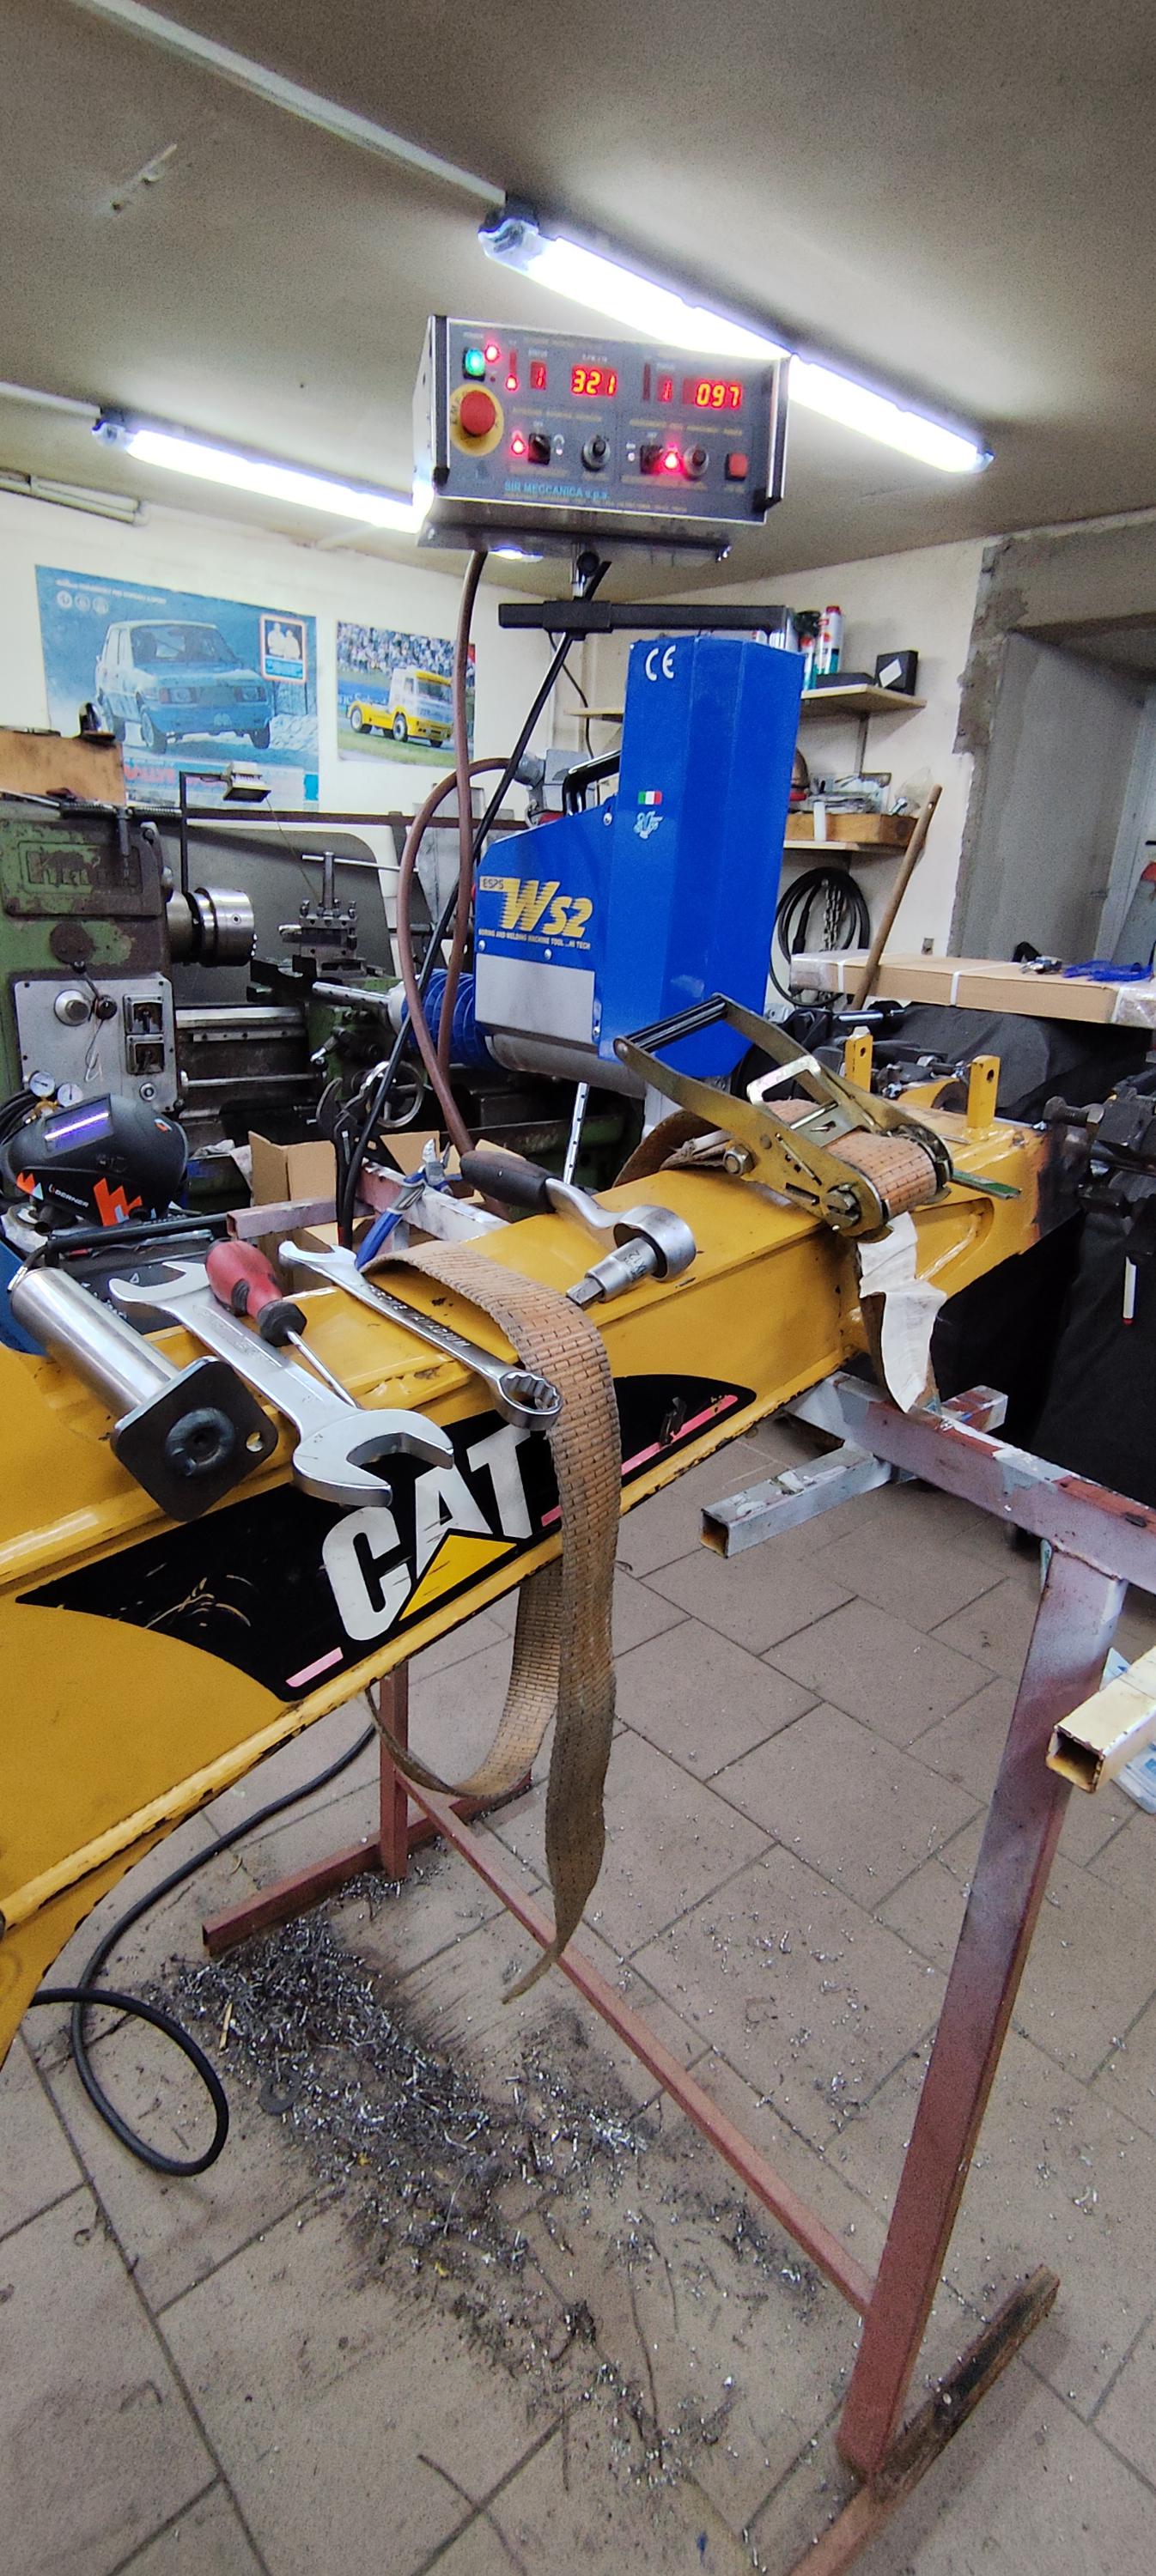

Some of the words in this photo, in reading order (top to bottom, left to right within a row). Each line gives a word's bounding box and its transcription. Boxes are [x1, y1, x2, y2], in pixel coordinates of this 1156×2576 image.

[573, 369, 617, 395] 321
[697, 383, 740, 408] 097
[504, 480, 521, 492] SIR
[523, 481, 583, 498] MECCANICA
[646, 645, 677, 682] CE
[322, 1423, 533, 1641] CAT
